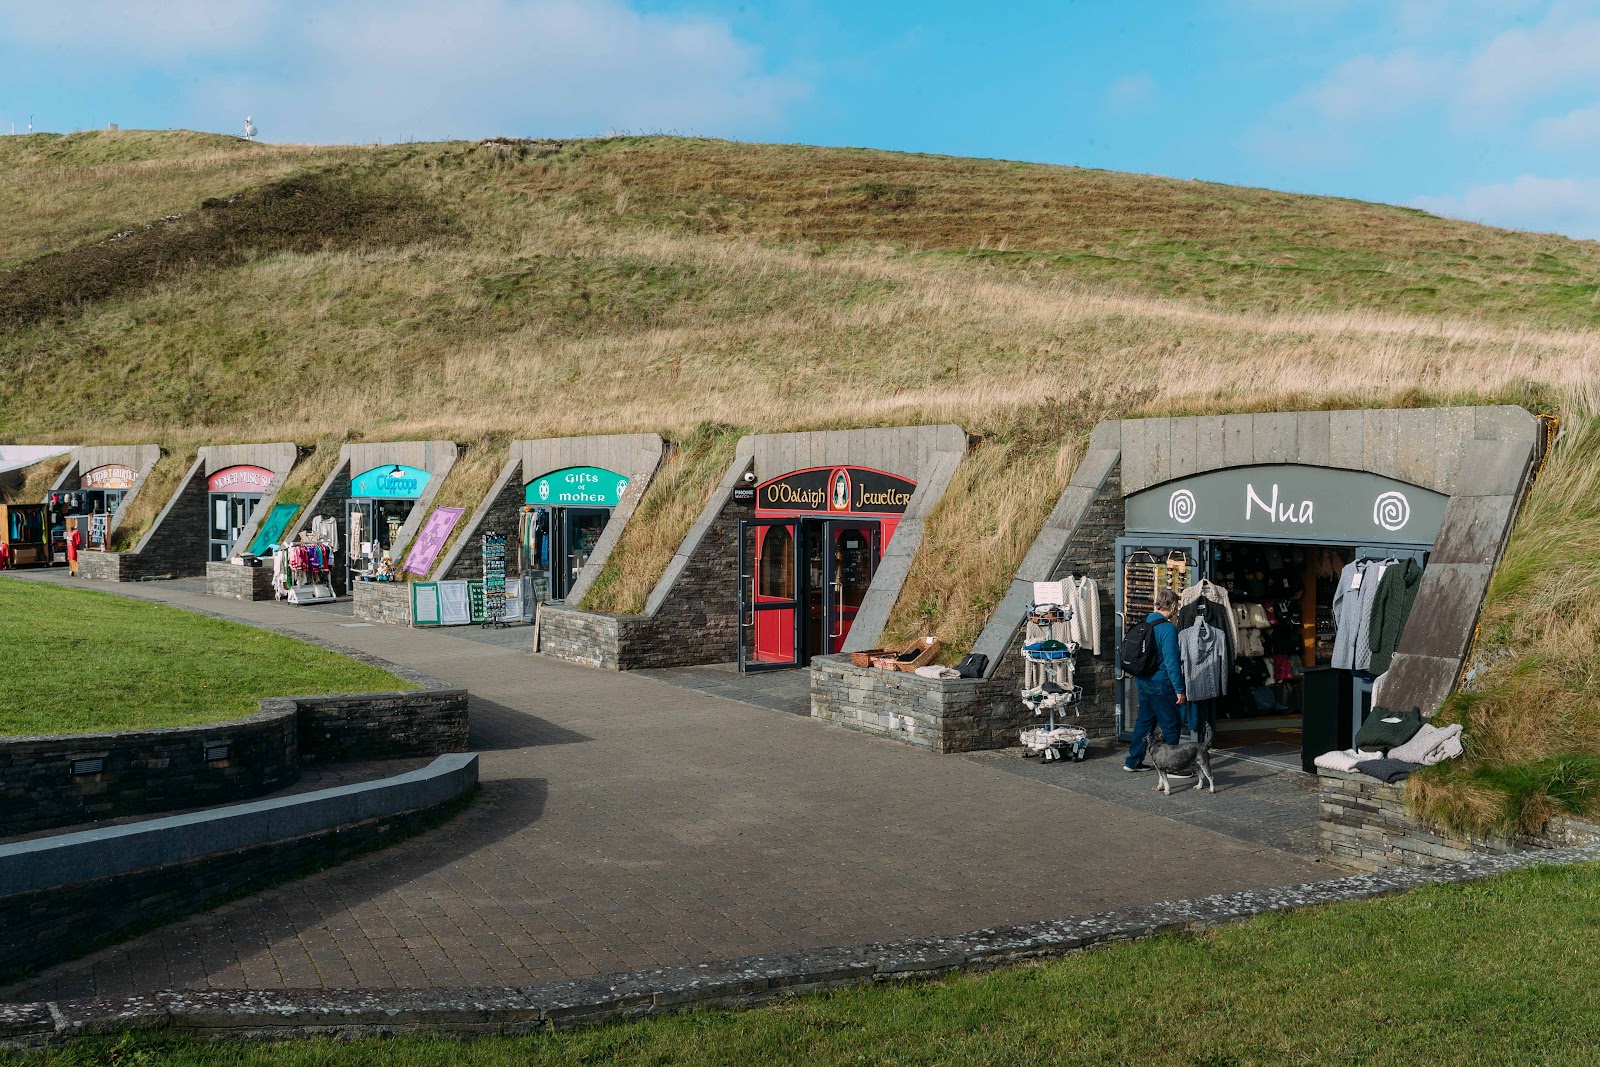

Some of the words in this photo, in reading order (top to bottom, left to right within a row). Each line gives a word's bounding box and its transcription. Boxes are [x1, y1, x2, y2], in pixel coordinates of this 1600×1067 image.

[565, 472, 599, 484] Gifts
[767, 482, 826, 508] O'Dalaigh
[856, 483, 913, 508] Jeweller
[1245, 483, 1314, 525] Nua
